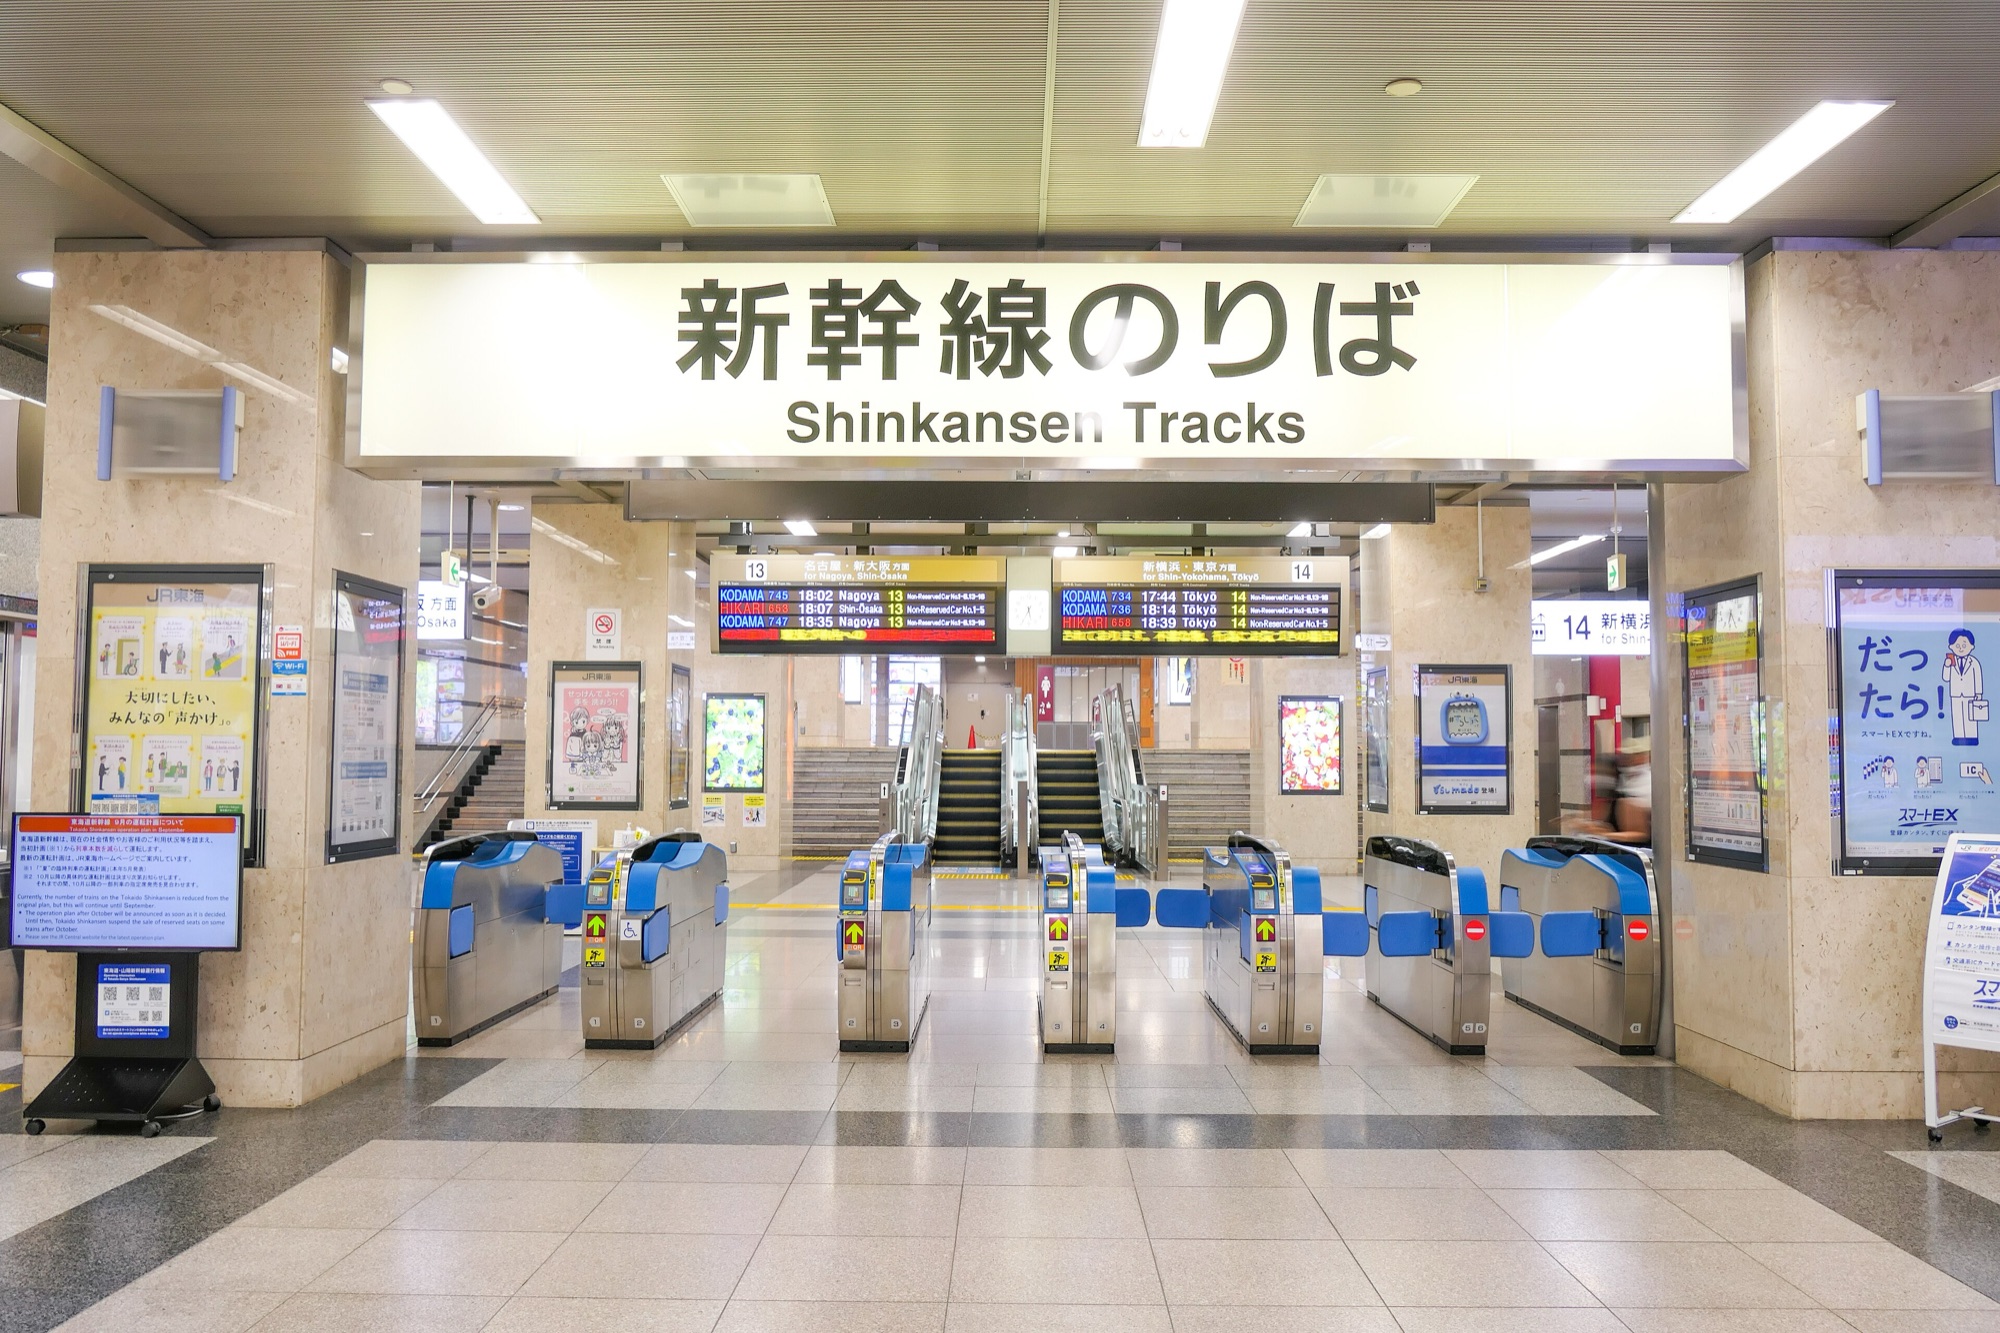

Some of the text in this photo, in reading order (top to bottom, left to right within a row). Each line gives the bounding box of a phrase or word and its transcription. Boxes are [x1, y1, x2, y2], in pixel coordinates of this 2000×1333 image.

[677, 279, 1418, 380] 新幹線のりば
[787, 401, 1305, 443] Shinkansen Tracks
[748, 563, 764, 578] 13
[804, 560, 910, 571] 名古屋・新大阪 方面
[1143, 562, 1217, 572] 新横浜・東京
[1294, 564, 1311, 579] 14
[819, 574, 854, 582] Nagoya,
[1158, 574, 1229, 582] Shin-Yokohama,
[147, 588, 204, 603] JR東海
[720, 590, 764, 602] KODAMA
[769, 591, 788, 600] 745
[799, 590, 833, 601] 18:02
[839, 590, 880, 602] Nagoya
[888, 590, 903, 602] 13
[1062, 590, 1107, 603] KODAMA
[1112, 592, 1131, 601] 734
[1142, 591, 1176, 602] 17:44
[1232, 592, 1246, 603] 14
[1895, 593, 1954, 608] JR東海
[431, 597, 456, 611] 方面
[720, 602, 764, 615] HIKARI
[769, 604, 788, 613] 653
[799, 603, 833, 614] 18:07
[888, 603, 903, 615] 13
[1062, 604, 1107, 616] KODAMA
[1112, 605, 1131, 614] 736
[1142, 604, 1176, 615] 18:14
[1232, 604, 1246, 616] 14
[720, 616, 764, 628] KODAMA
[769, 617, 788, 627] 747
[799, 617, 833, 628] 18:35
[839, 617, 880, 628] Nagoya
[888, 617, 903, 628] 13
[1062, 617, 1107, 629] HIKARI
[1112, 618, 1131, 627] 658
[1142, 618, 1176, 628] 18:39
[1232, 618, 1246, 629] 14
[1564, 615, 1591, 640] 14
[1602, 634, 1616, 644] for
[1858, 636, 1928, 672] だっ
[285, 662, 304, 670] Wi-Fi
[582, 673, 612, 681] JR東海
[1448, 676, 1478, 684] JR東海
[126, 691, 216, 705] 大切にしたい、
[1859, 683, 1945, 720] たら!
[109, 711, 231, 727] みんなの「声かけ」。
[1862, 730, 1932, 738] スマートEXですね。
[1966, 766, 1976, 774] IC
[1898, 808, 1959, 822] スマートEX
